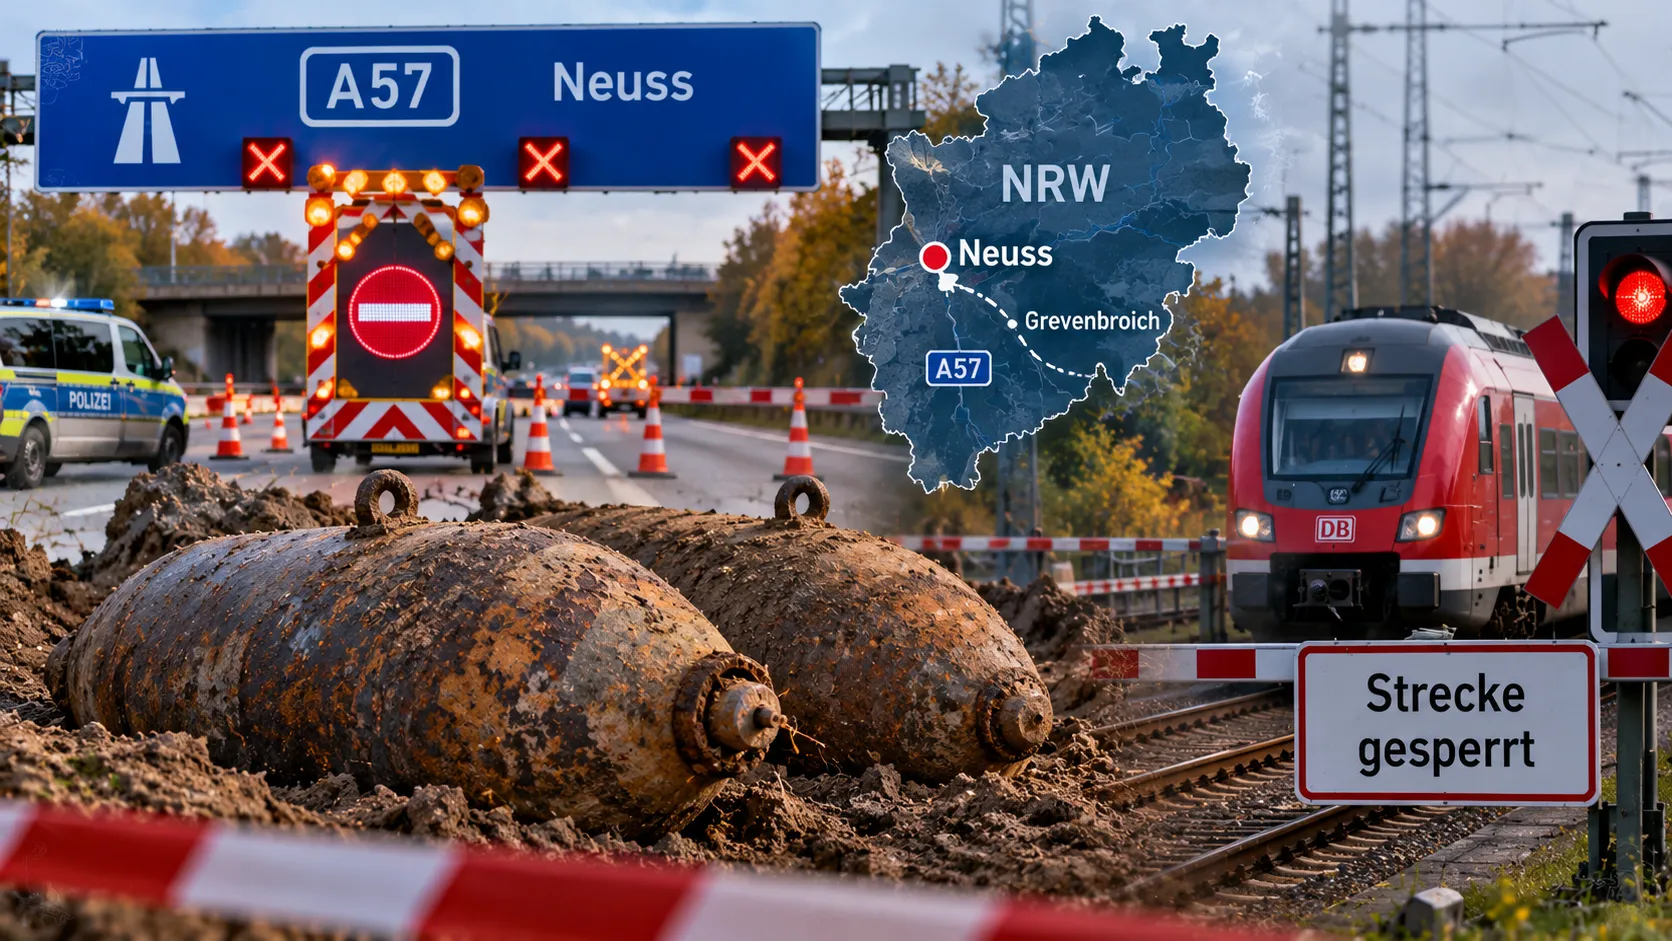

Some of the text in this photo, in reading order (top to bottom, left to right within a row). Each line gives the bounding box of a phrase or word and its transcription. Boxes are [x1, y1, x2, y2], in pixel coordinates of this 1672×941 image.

[326, 62, 433, 109] A57
[554, 62, 693, 101] Neuss
[69, 391, 111, 410] POLIZEI
[1321, 520, 1350, 538] DB
[1367, 672, 1525, 713] Strecke
[1358, 730, 1535, 778] gesperrt
